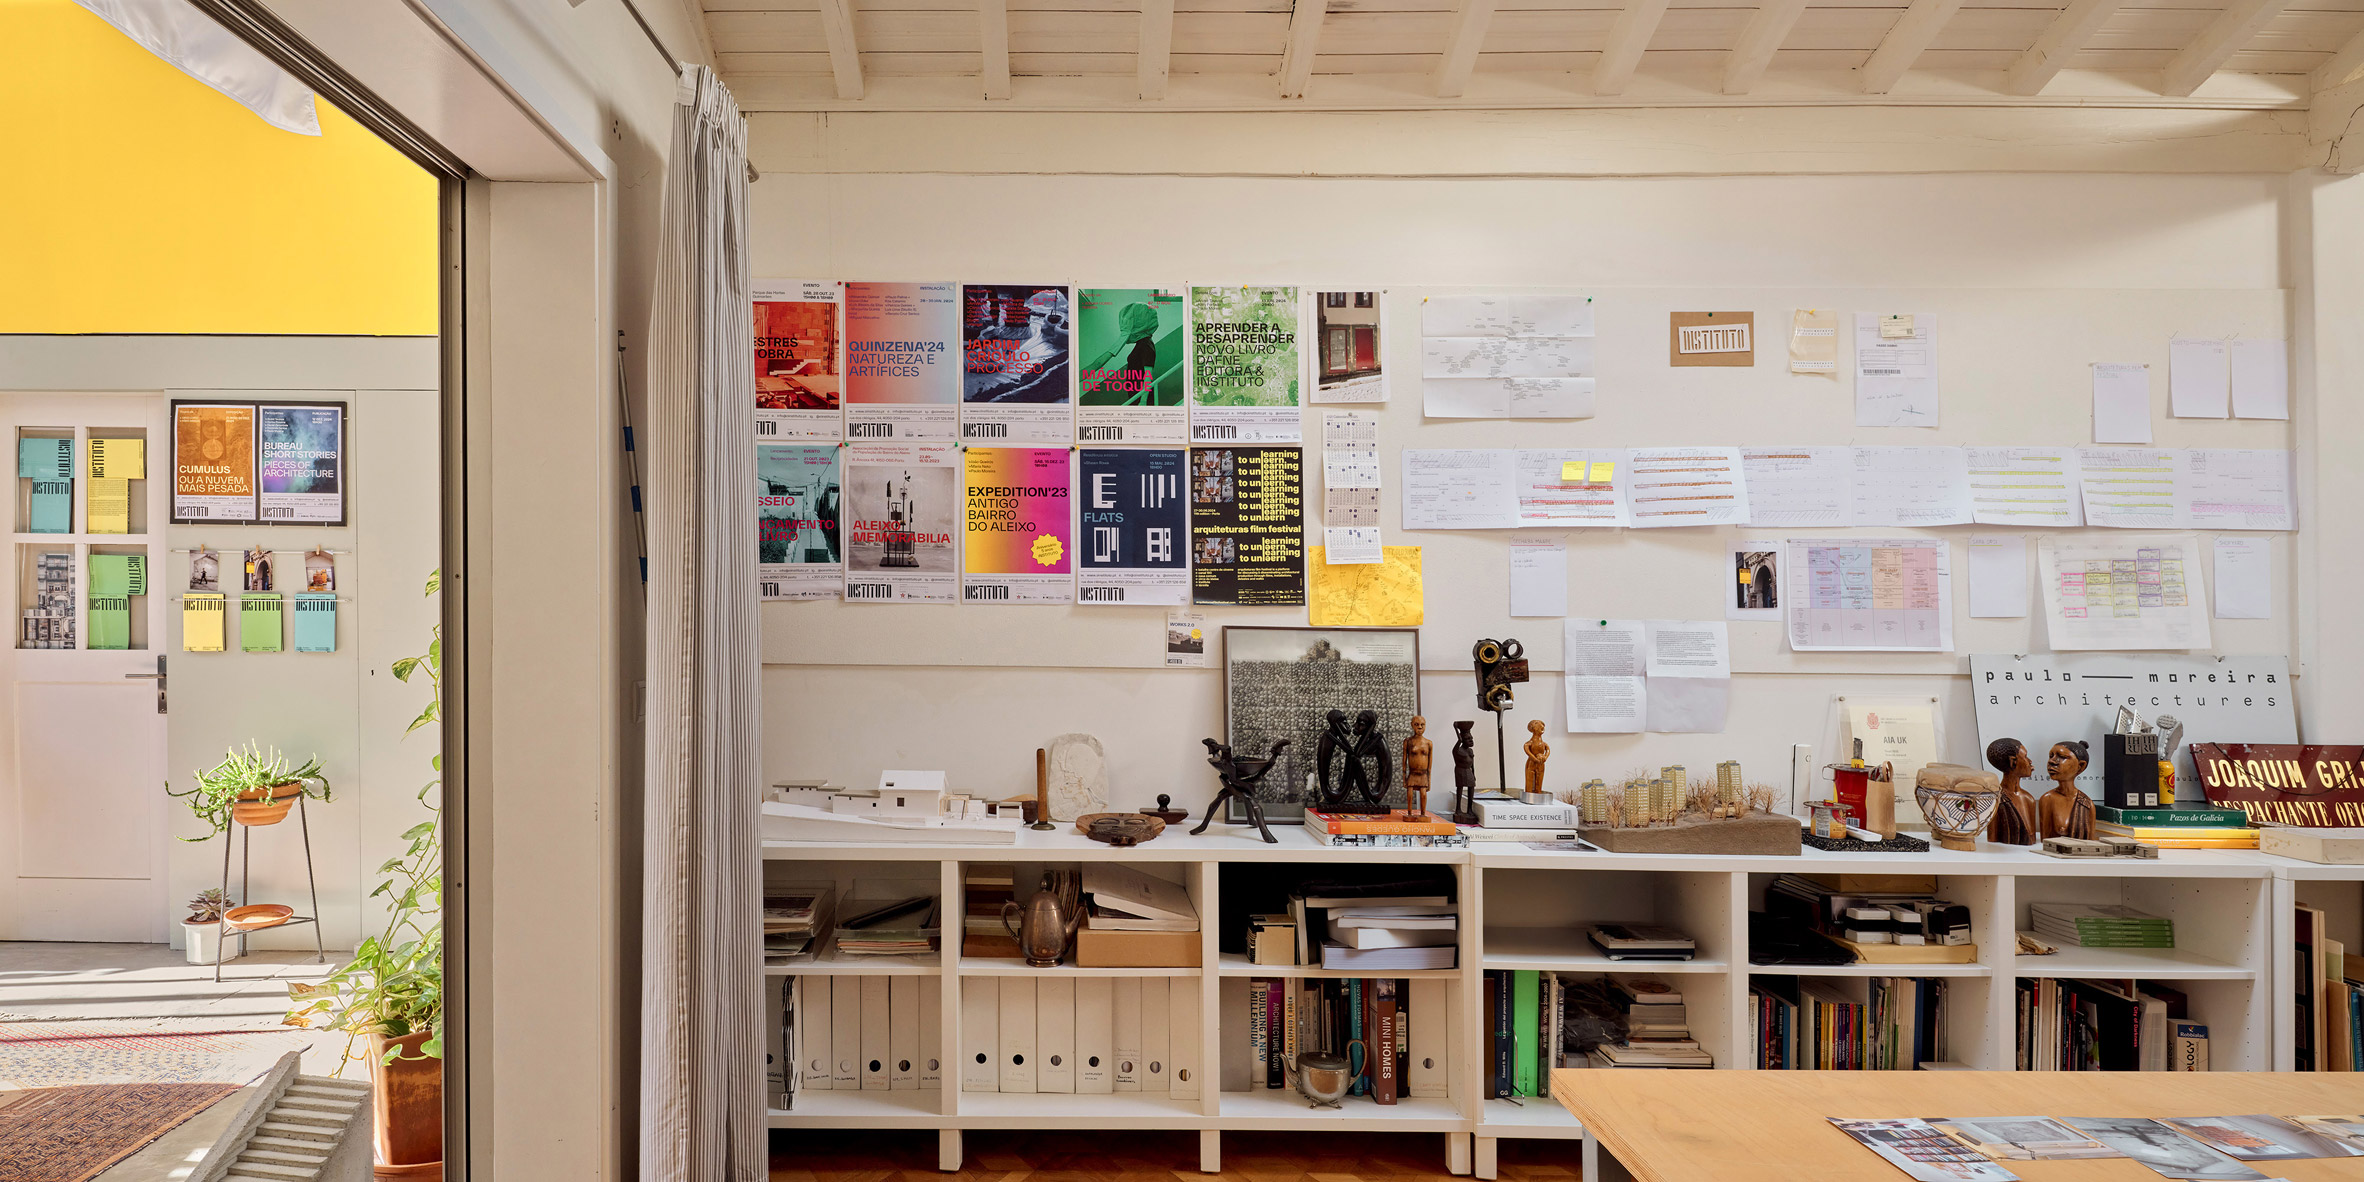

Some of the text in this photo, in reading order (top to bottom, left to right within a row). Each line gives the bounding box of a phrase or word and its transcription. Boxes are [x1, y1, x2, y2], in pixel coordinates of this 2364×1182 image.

[1196, 323, 1281, 332] APRENDER A
[1196, 334, 1294, 343] DESAPRENDER
[1684, 329, 1744, 350] INSTITUTO
[849, 342, 945, 352] QUINZENA'24
[966, 339, 1020, 350] JARDIM
[1197, 344, 1276, 354] NOVO LIVRO
[758, 349, 794, 359] OBRA
[849, 354, 934, 364] NATUREZA E
[966, 351, 1030, 362] CRIOULO
[1197, 356, 1240, 365] DAFNE
[849, 364, 920, 377] ARTÍFICES
[967, 362, 1043, 374] PROCESSO
[1082, 367, 1153, 380] MÁQUINA
[1197, 366, 1264, 376] EDITORA &
[1082, 381, 1152, 392] DE TOQUE
[1197, 377, 1264, 387] INSTITUTO
[849, 423, 893, 437] INSTITUTO
[963, 423, 1007, 437] INSTITUTO
[1079, 426, 1122, 440] INSTITUTO
[1194, 425, 1237, 439] INSTITUTO
[264, 442, 303, 450] BUREAU
[58, 440, 71, 478] INSTITUTO
[92, 440, 104, 478] INSTITUTO
[264, 450, 337, 459] SHORT STORIES
[179, 465, 230, 474] CUMULUS
[298, 461, 310, 469] OF
[264, 469, 334, 478] ARCHITECTURE
[179, 475, 244, 485] OU A NUVEM
[32, 482, 69, 494] INSTITUTO
[179, 484, 249, 493] MAIS PESADA
[968, 487, 1067, 497] EXPEDITION'23
[968, 499, 1019, 508] ANTIGO
[969, 510, 1016, 520] BAIRRO
[1084, 512, 1124, 523] FLATS
[853, 521, 901, 531] ALEIXO
[969, 522, 1036, 532] DO ALEIXO
[1194, 526, 1249, 535] arquiteturas
[759, 532, 798, 541] LIVRO
[853, 532, 951, 543] MEMORABILIA
[128, 556, 142, 594] INSTITUTO
[848, 583, 891, 598] INSTITUTO
[965, 585, 1009, 600] INSTITUTO
[1080, 587, 1124, 601] INSTITUTO
[90, 598, 128, 610] INSTITUTO
[1986, 669, 2276, 684] paulo moreira
[1990, 692, 2276, 707] architectures
[2207, 759, 2307, 791] JOAQUIM
[2213, 801, 2332, 826] PACHANTE
[1382, 1017, 1391, 1079] MINI HOMES
